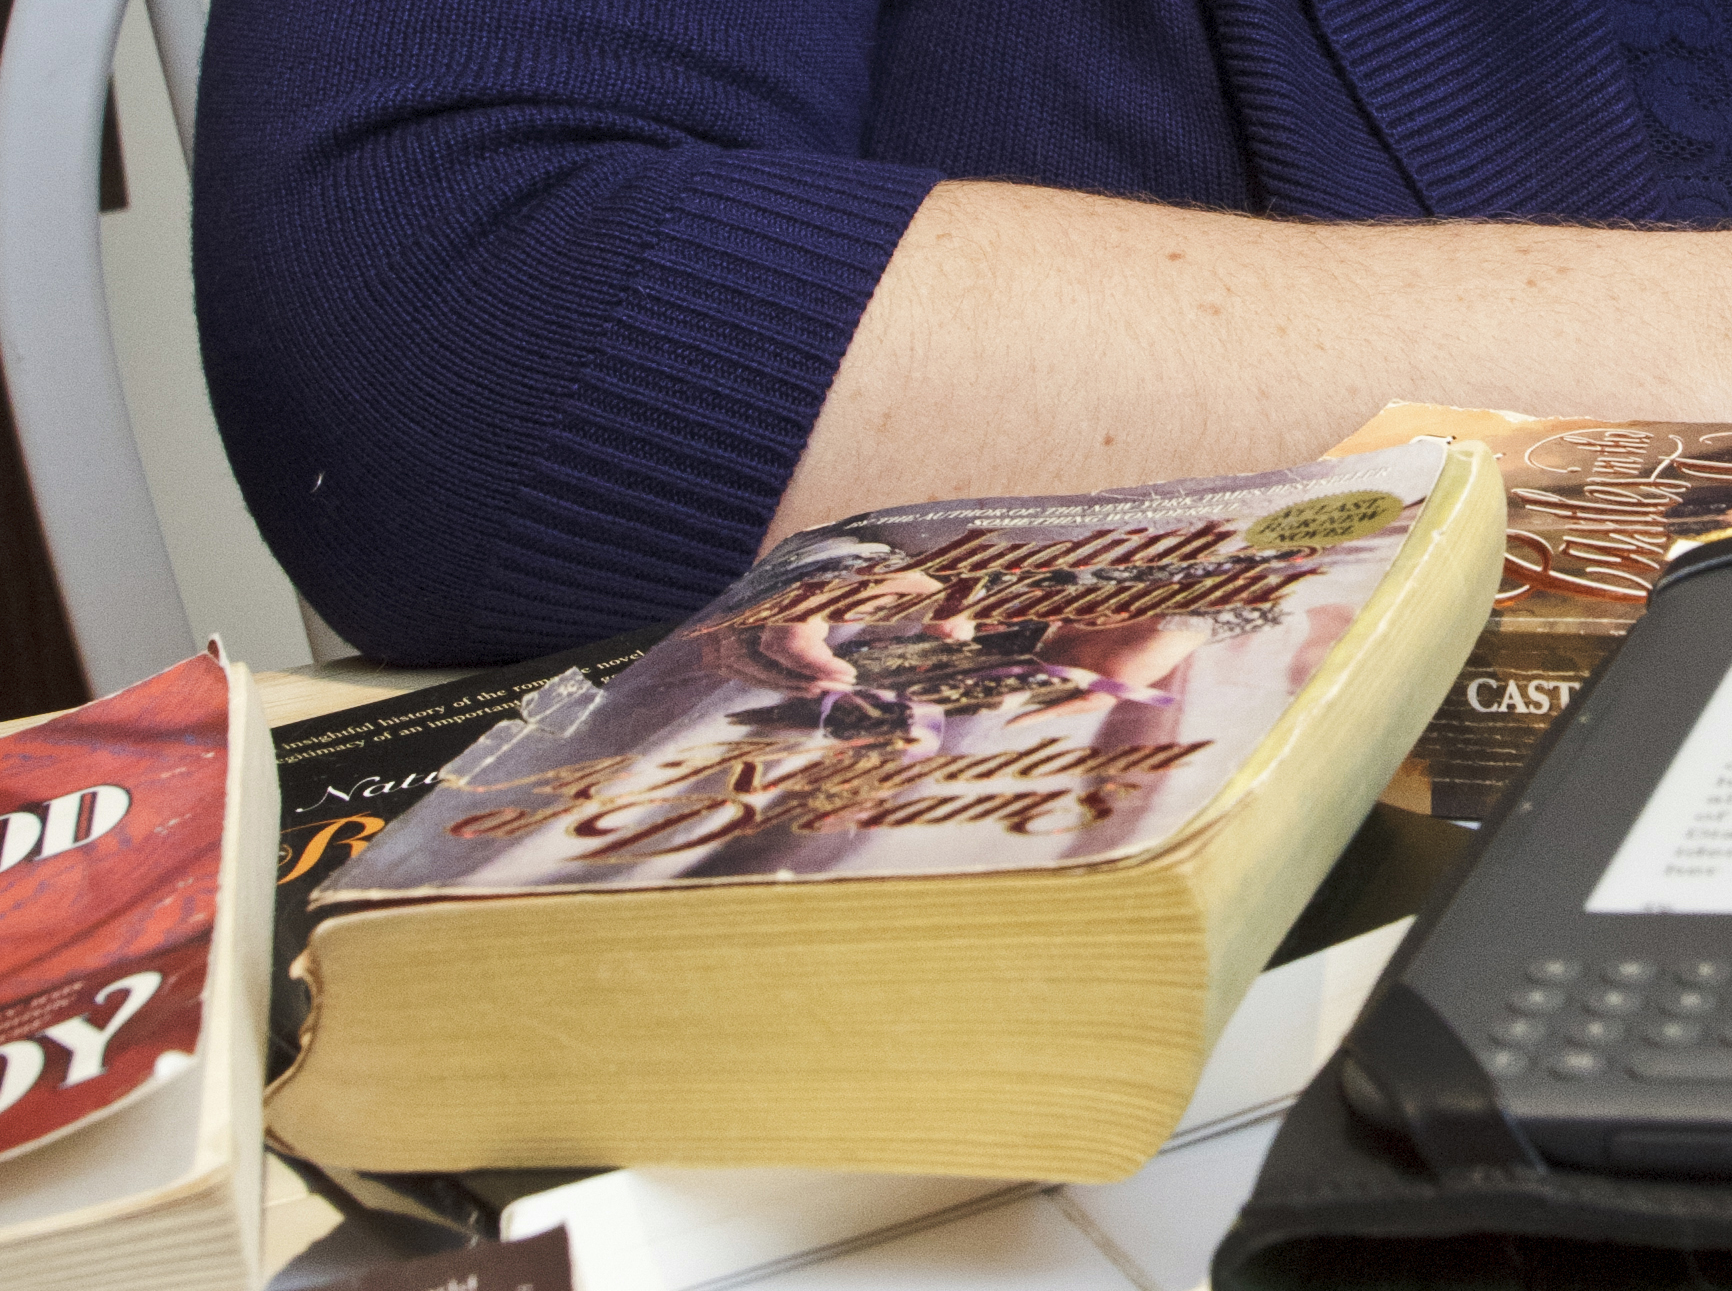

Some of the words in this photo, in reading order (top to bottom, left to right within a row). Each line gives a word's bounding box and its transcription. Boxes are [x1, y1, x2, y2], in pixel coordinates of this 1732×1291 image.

[860, 519, 1275, 577] Judith
[282, 722, 375, 749] insightful
[377, 705, 445, 727] history
[453, 696, 472, 708] of
[477, 689, 507, 702] the
[1467, 677, 1582, 714] CAST
[277, 739, 365, 764] egitimacy
[373, 730, 393, 742] of
[398, 725, 423, 736] an
[426, 699, 521, 729] important
